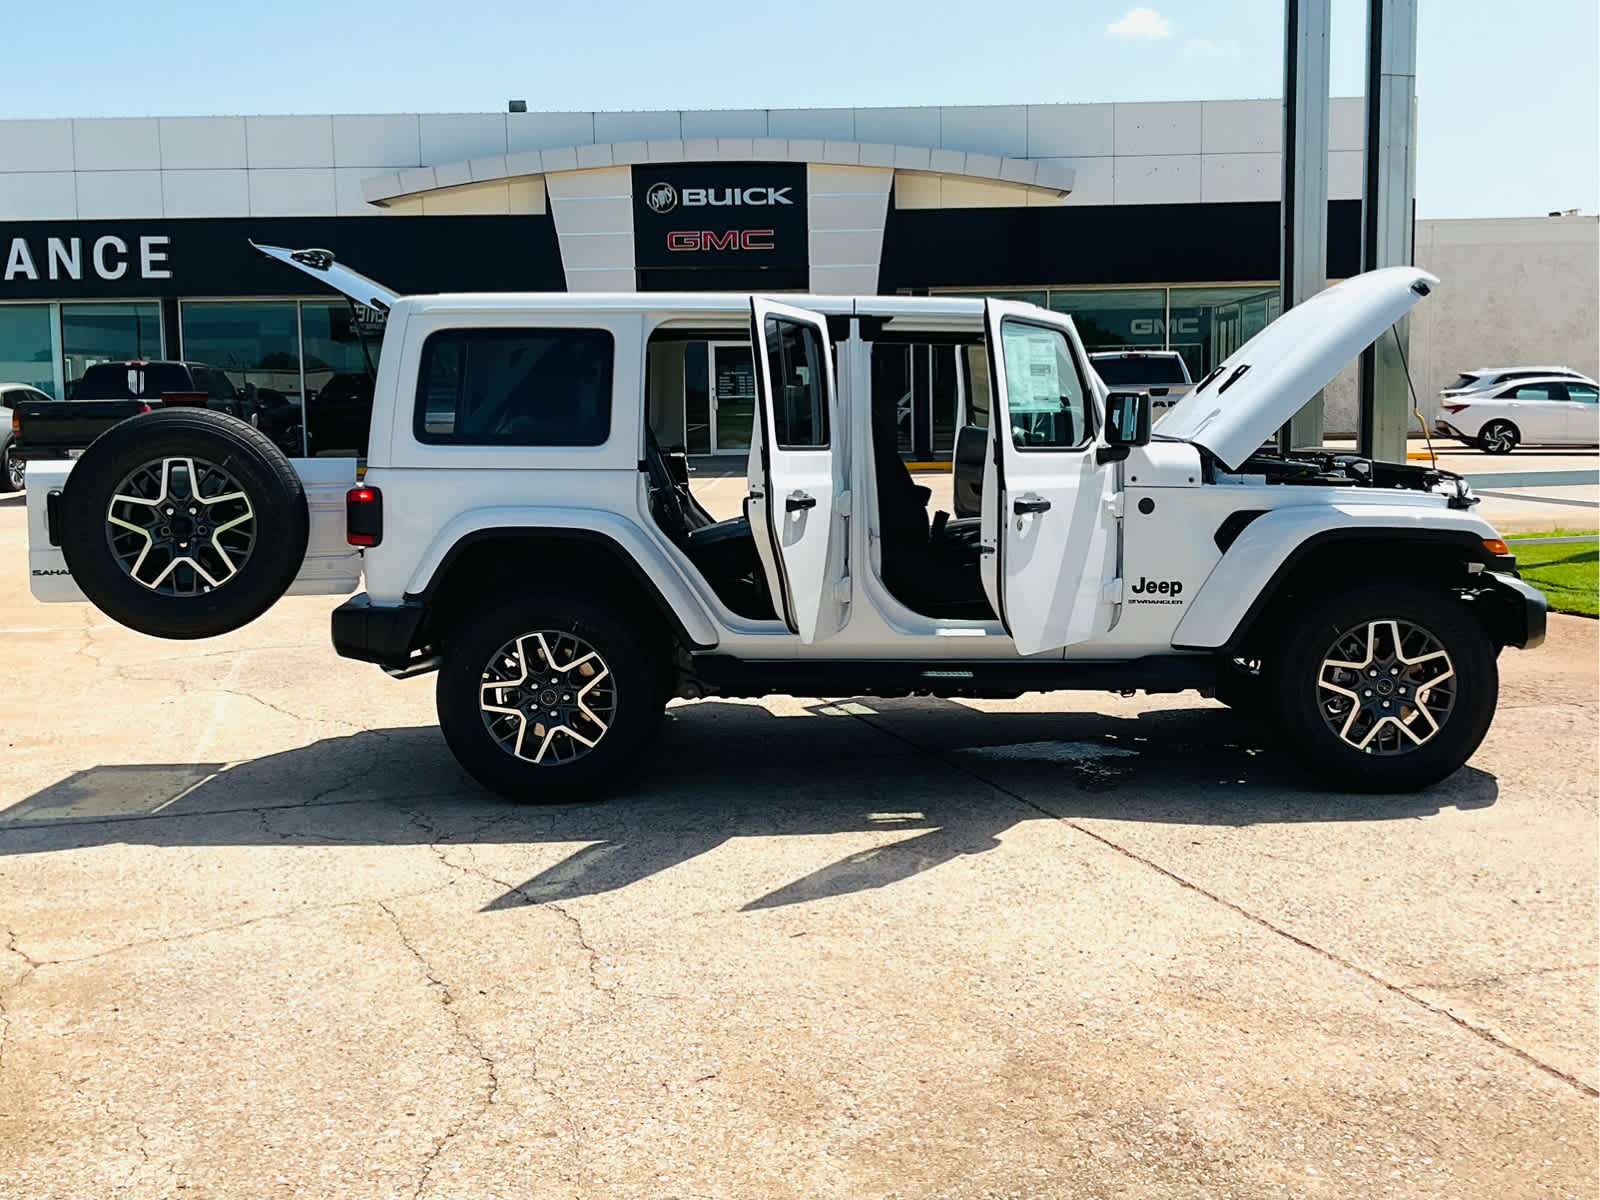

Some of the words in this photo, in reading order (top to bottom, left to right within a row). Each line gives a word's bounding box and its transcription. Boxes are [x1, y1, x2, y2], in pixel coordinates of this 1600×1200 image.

[682, 187, 794, 206] BUICK
[667, 229, 775, 251] GMC
[4, 235, 173, 281] ANCE
[1130, 318, 1200, 335] GMC
[1131, 576, 1183, 597] Jeep
